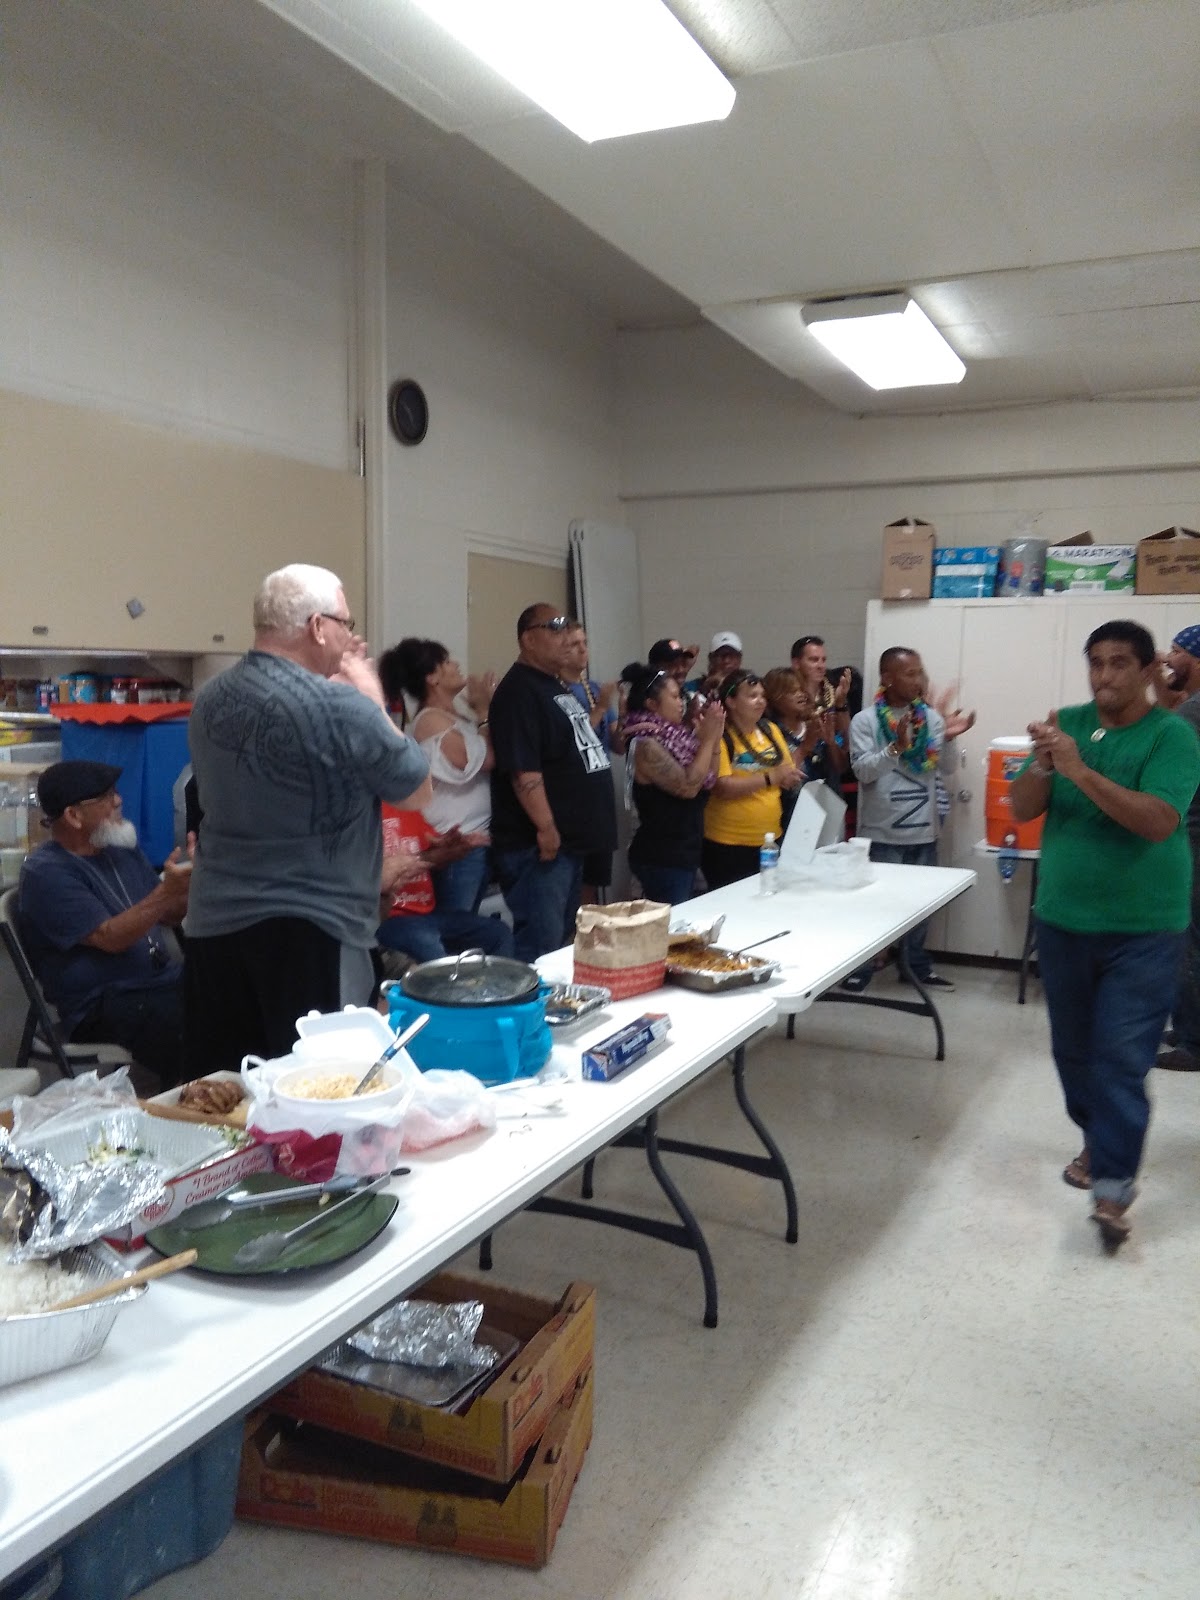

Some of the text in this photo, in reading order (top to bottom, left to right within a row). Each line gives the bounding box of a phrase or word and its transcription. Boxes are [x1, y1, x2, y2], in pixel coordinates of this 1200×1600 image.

[202, 1166, 231, 1185] Brand
[232, 1162, 240, 1174] of
[185, 1184, 220, 1203] Creamer
[222, 1179, 231, 1188] in
